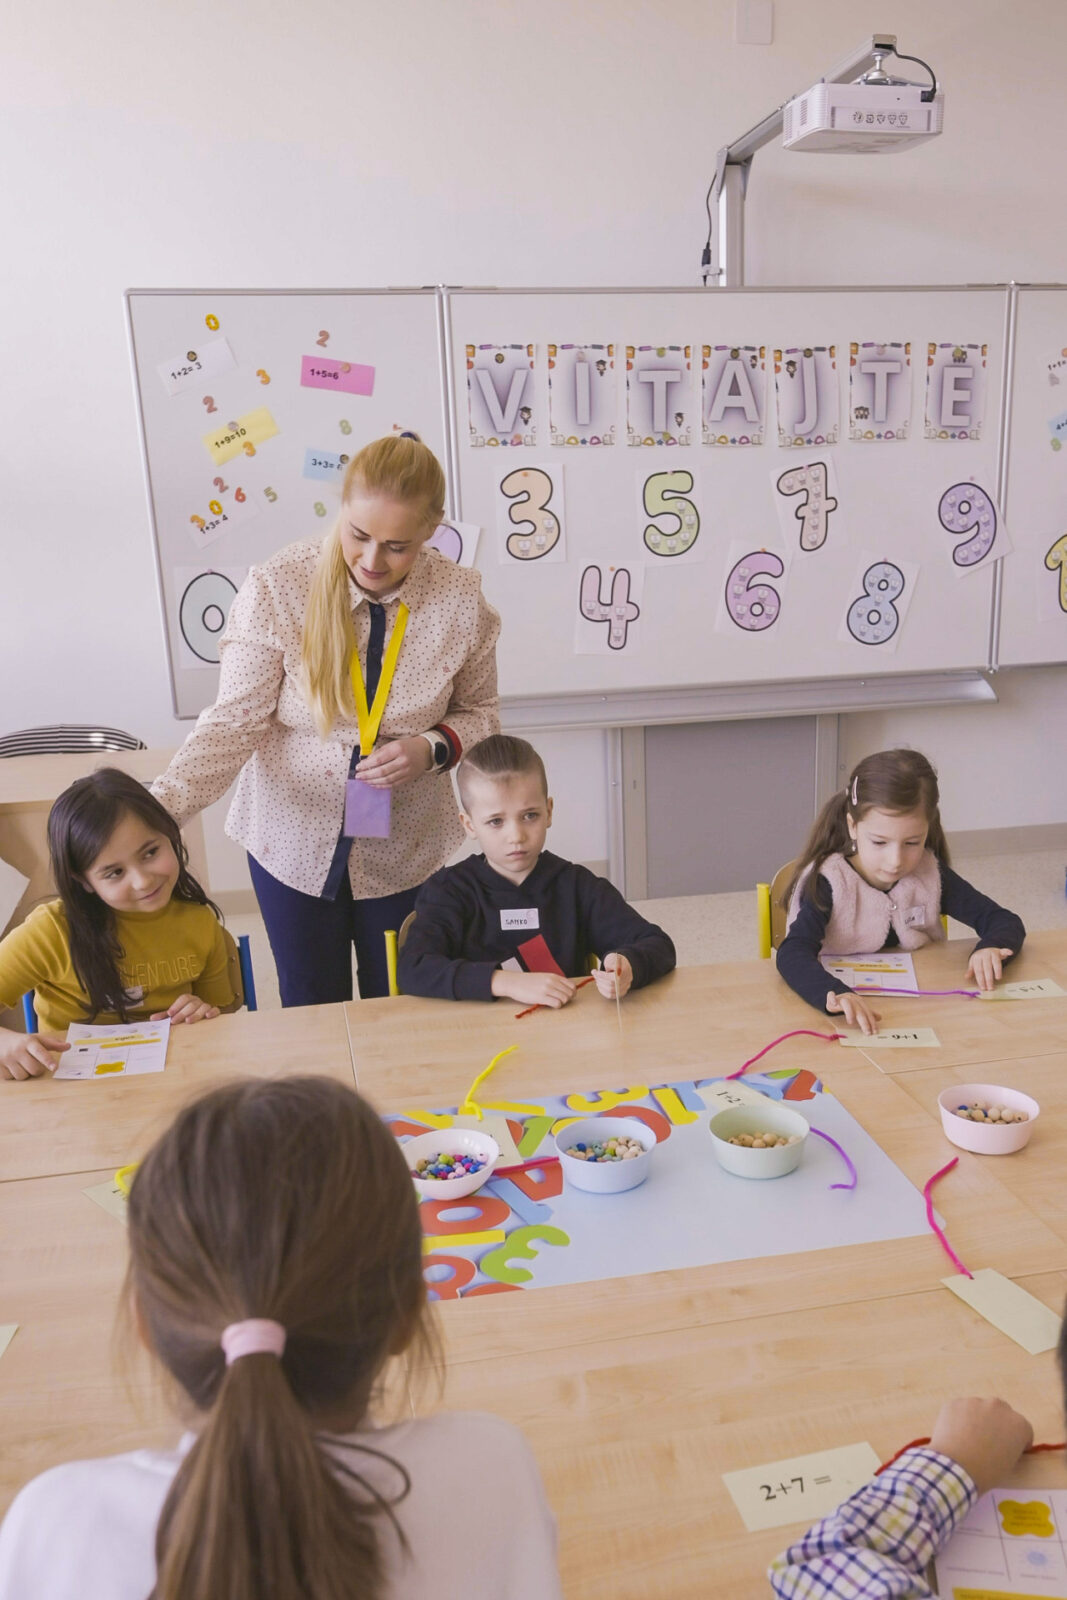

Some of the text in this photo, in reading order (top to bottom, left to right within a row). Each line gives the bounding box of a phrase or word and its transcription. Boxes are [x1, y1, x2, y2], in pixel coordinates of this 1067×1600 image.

[205, 313, 220, 331] 0
[316, 330, 330, 348] 2
[256, 368, 271, 386] 3
[310, 368, 340, 380] 1+5=6
[202, 395, 218, 414] 2
[214, 428, 247, 449] 1+9=10
[243, 441, 257, 457] 3
[213, 476, 229, 494] 2
[234, 486, 247, 503] 6
[263, 486, 278, 503] 5
[208, 499, 223, 516] 0
[499, 466, 561, 561] 3
[642, 469, 701, 558] 5
[776, 461, 838, 553] 7
[190, 514, 206, 529] 3
[937, 481, 998, 568] 9
[724, 550, 785, 632] 6
[579, 564, 640, 652] 4
[845, 561, 905, 646] 8
[759, 1476, 806, 1501] 2+7
